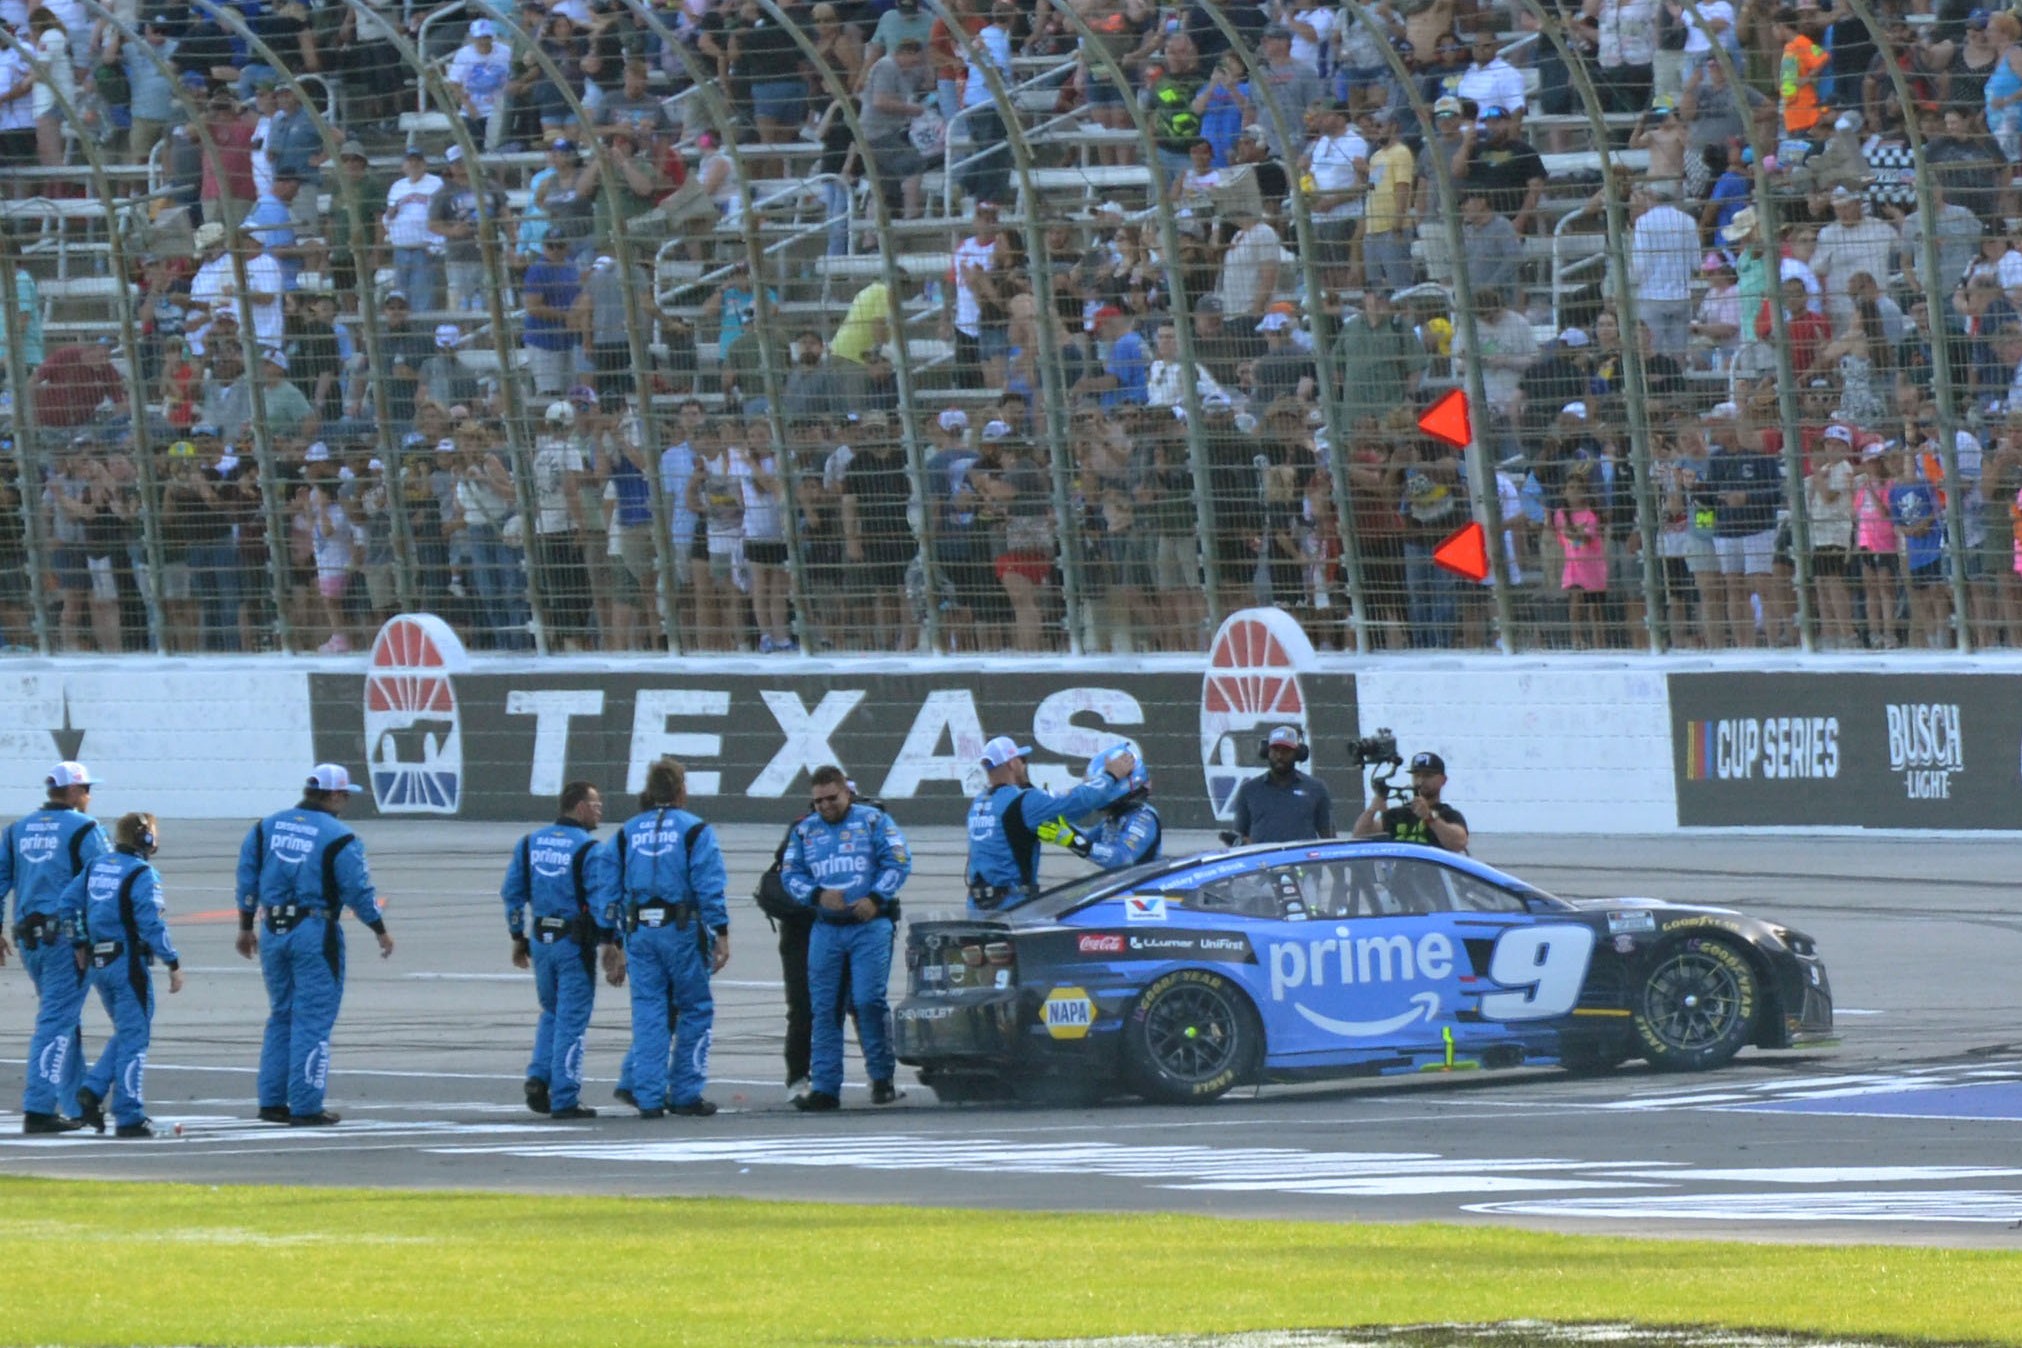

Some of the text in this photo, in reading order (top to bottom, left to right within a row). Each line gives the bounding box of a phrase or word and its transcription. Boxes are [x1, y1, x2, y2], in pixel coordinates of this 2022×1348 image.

[505, 687, 1145, 800] TEXAS
[1716, 717, 1840, 780] CUP SERIES
[1885, 703, 1963, 771] BUSCH
[1907, 771, 1950, 799] LIGHT
[270, 834, 314, 853] prime
[531, 848, 571, 866] prime
[810, 854, 868, 880] prime
[1193, 868, 1217, 881] Blue
[1662, 915, 1740, 932] GOODYEAR
[1200, 938, 1244, 950] UniFirst
[1269, 926, 1453, 1000] prime
[1480, 923, 1595, 1022] 9
[994, 969, 1010, 990] 9
[1050, 1001, 1088, 1023] NAPA
[313, 1041, 329, 1089] prime
